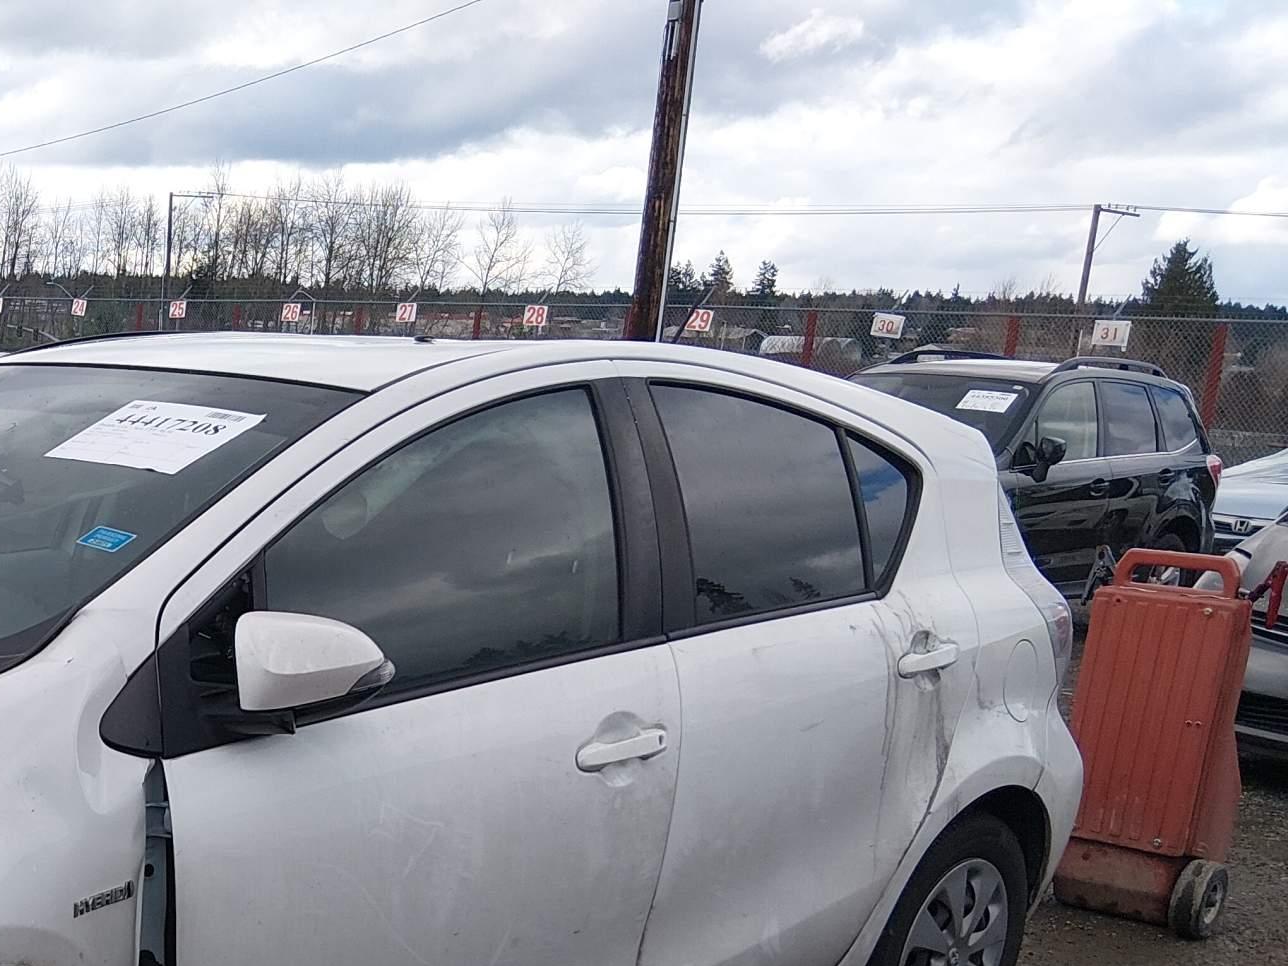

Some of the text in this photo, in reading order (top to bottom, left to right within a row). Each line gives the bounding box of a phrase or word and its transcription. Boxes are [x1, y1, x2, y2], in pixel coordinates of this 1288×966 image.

[73, 300, 84, 314] 24
[171, 302, 185, 317] 25
[283, 304, 298, 320] 26
[398, 304, 414, 321] 27
[525, 306, 546, 325] 28
[686, 310, 711, 330] 29
[878, 319, 895, 333] 30
[1100, 327, 1118, 341] 31
[115, 413, 227, 436] 44417208
